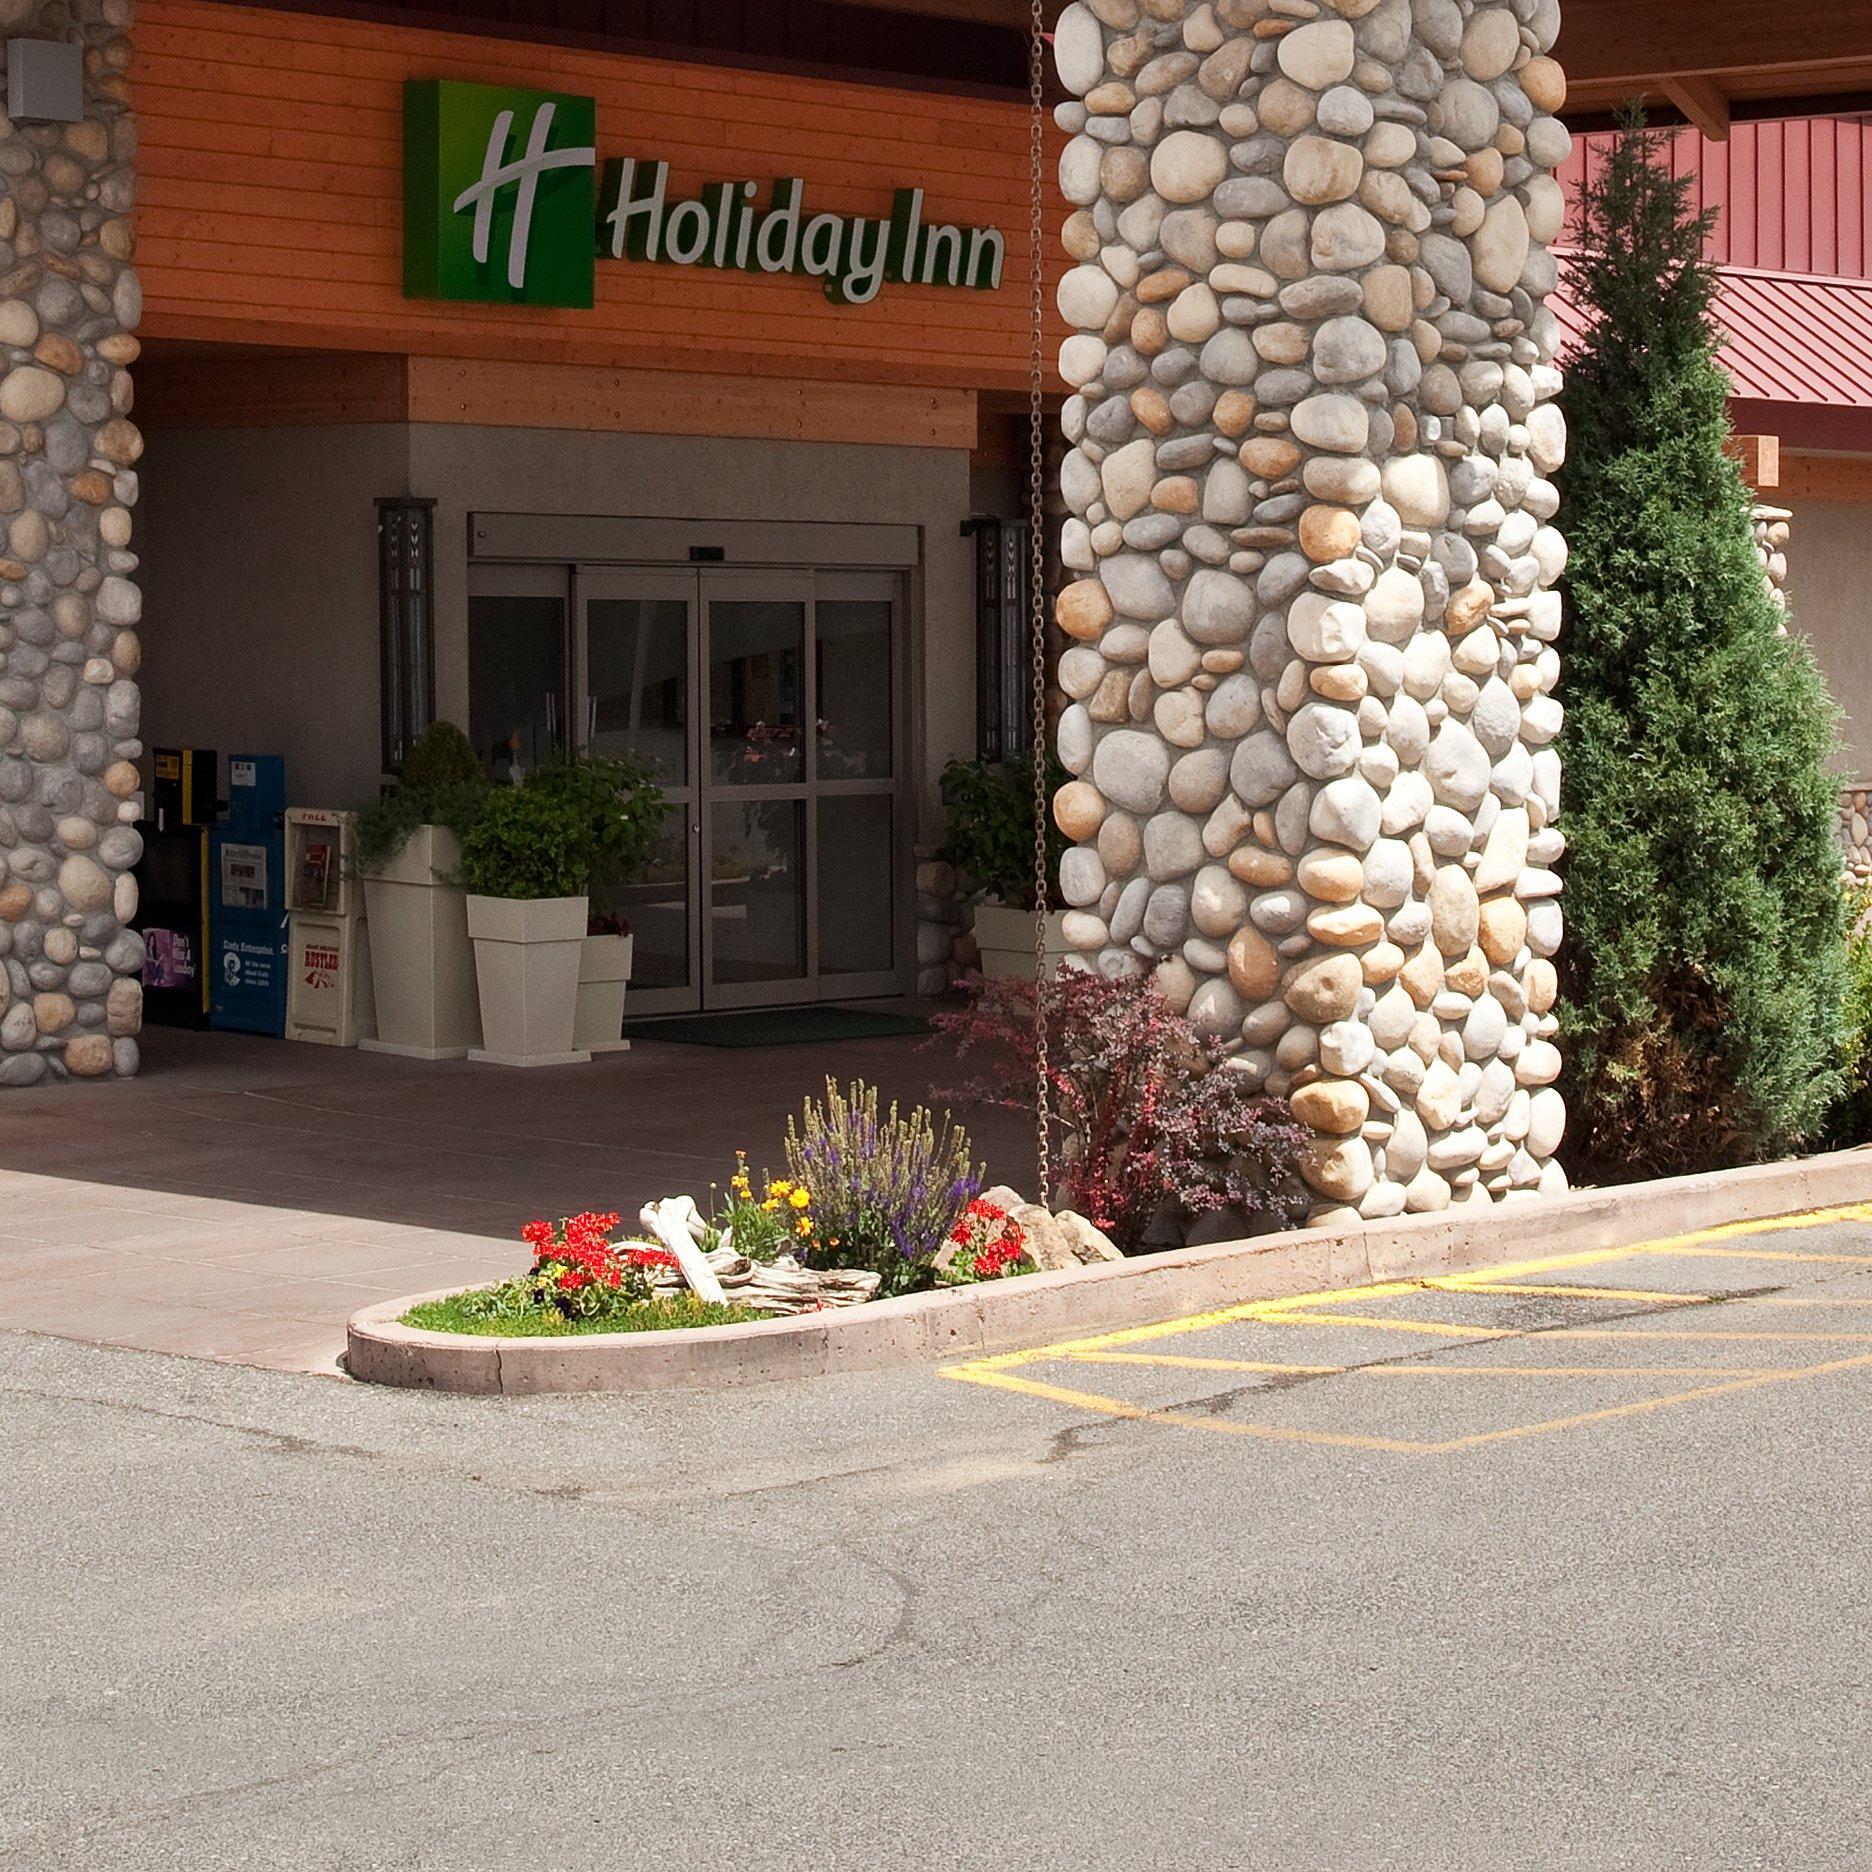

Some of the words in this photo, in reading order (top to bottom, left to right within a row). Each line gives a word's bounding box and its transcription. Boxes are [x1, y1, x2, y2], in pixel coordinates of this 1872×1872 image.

[606, 157, 890, 304] Holiday
[901, 187, 1005, 290] Inn
[302, 812, 327, 822] FREE
[223, 939, 238, 953] Cody
[240, 942, 274, 955] Enterprise
